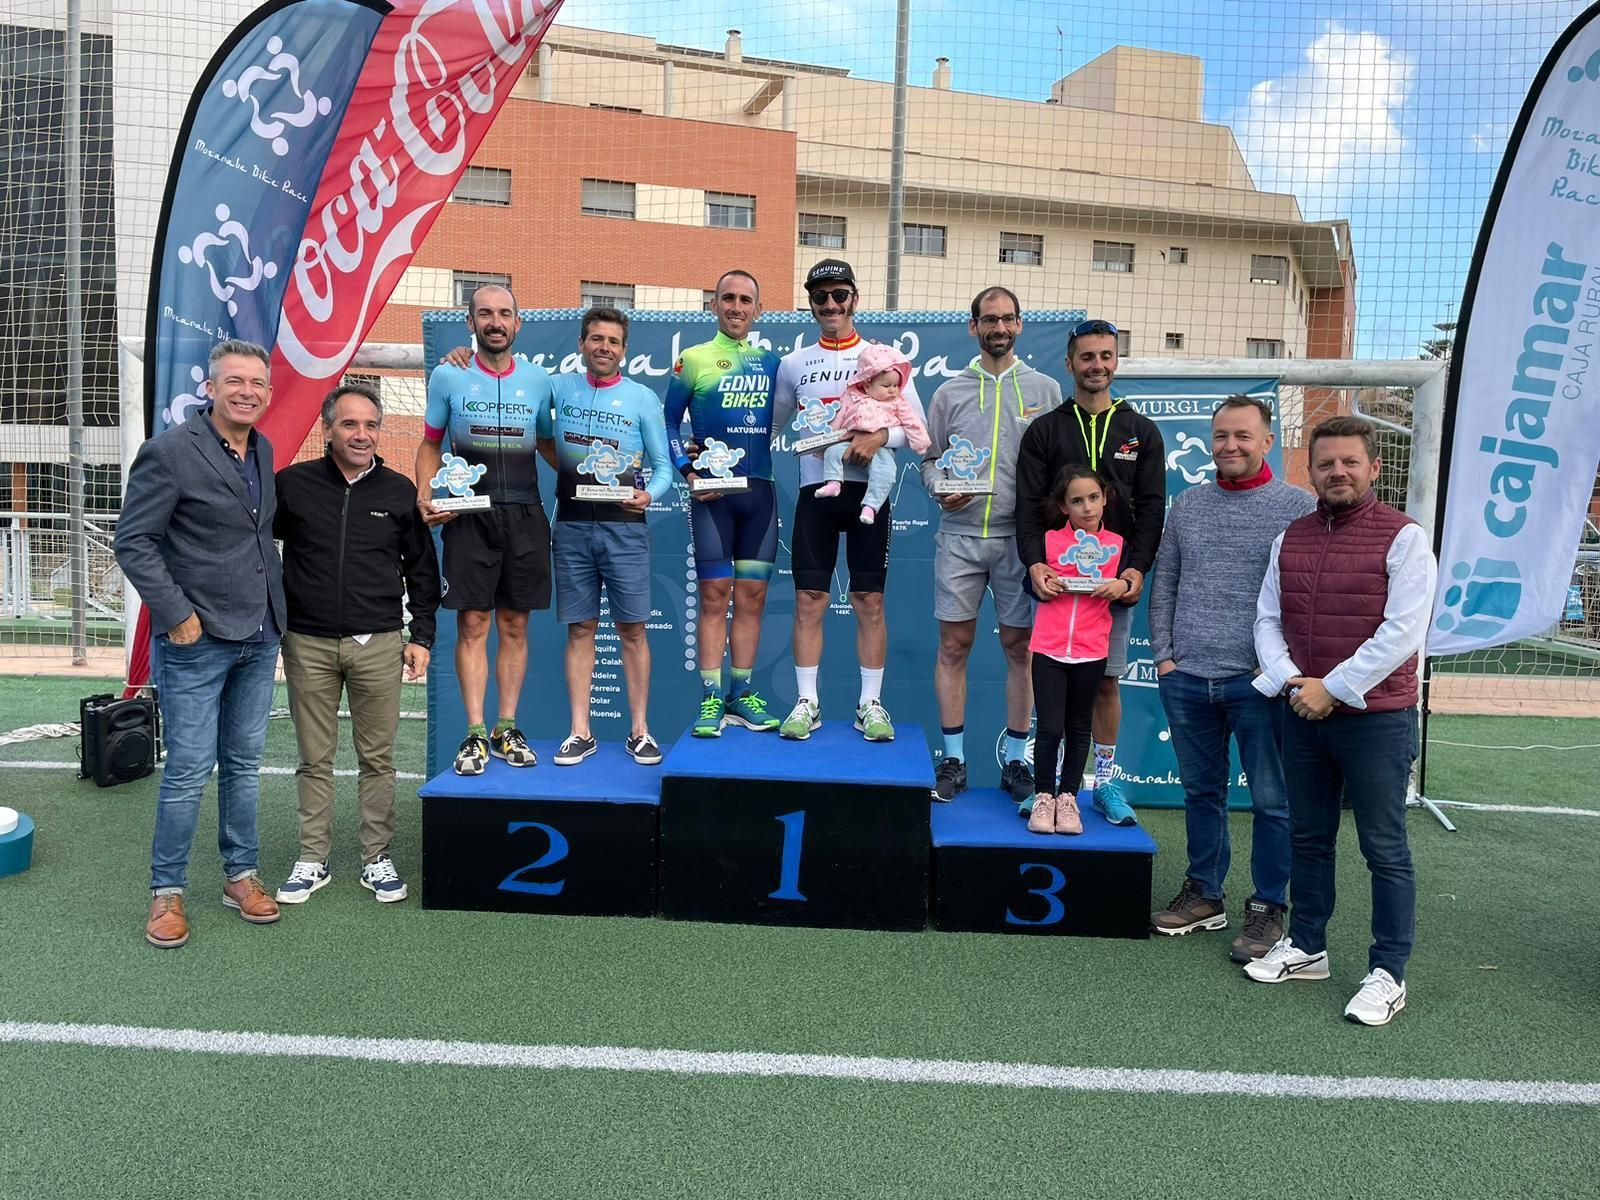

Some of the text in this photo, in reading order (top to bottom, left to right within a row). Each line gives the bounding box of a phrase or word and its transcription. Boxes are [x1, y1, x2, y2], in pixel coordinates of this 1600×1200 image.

[1541, 116, 1600, 145] Moza
[1566, 148, 1600, 176] Bik
[1551, 176, 1600, 205] Rac
[217, 326, 231, 341] Bik
[717, 375, 770, 392] GONVI
[800, 369, 858, 386] GENUI
[1562, 343, 1593, 400] CAJA
[721, 391, 769, 409] BIKES
[1479, 241, 1588, 538] cajamar
[645, 622, 673, 630] uesado
[590, 684, 621, 692] Ferreira
[590, 697, 611, 705] Dolar
[497, 821, 570, 896] 2
[767, 811, 808, 902] 1
[1005, 863, 1067, 926] 3
